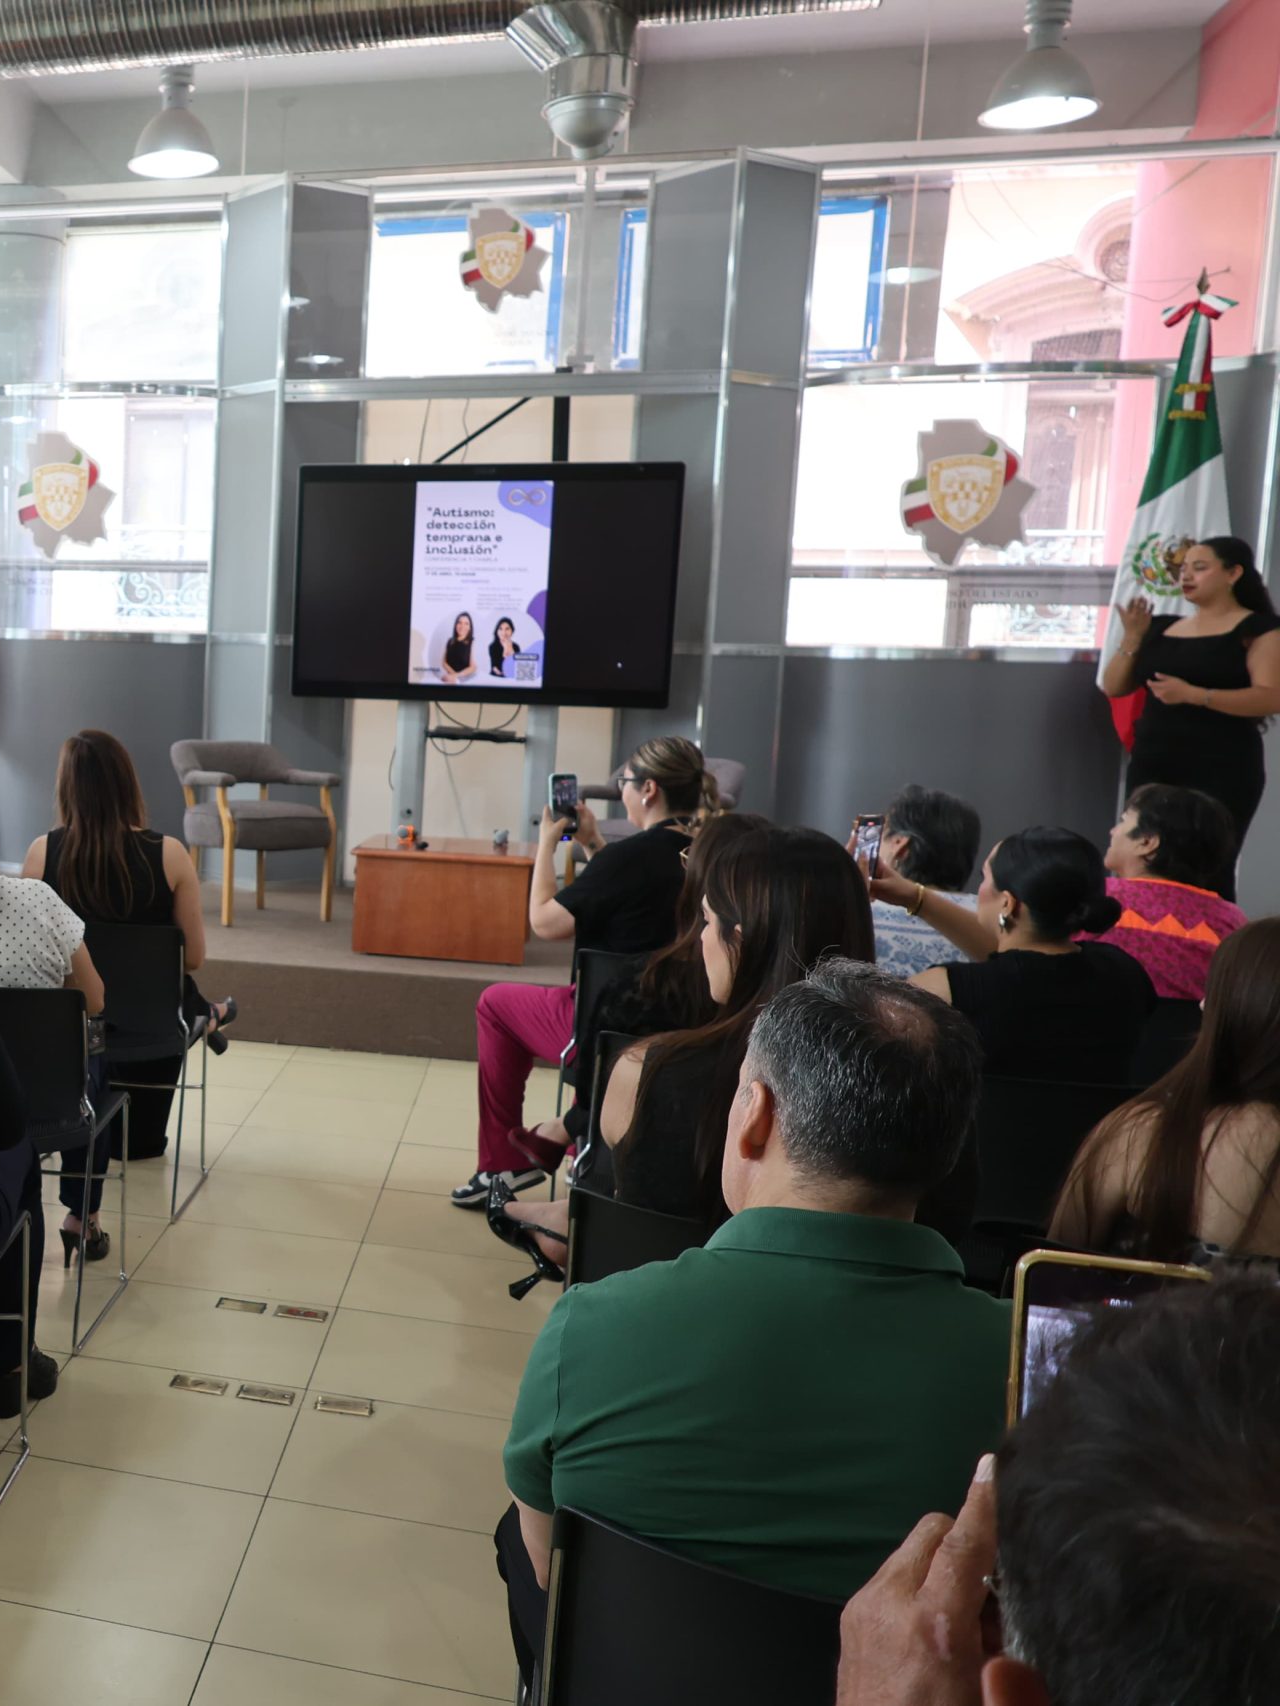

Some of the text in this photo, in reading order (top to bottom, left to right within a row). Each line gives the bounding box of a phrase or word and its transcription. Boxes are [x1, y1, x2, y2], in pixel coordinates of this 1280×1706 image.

[427, 507, 495, 518] "Autismo:
[426, 520, 496, 530] detección
[426, 533, 491, 544] temprana
[426, 545, 498, 555] inclusión"
